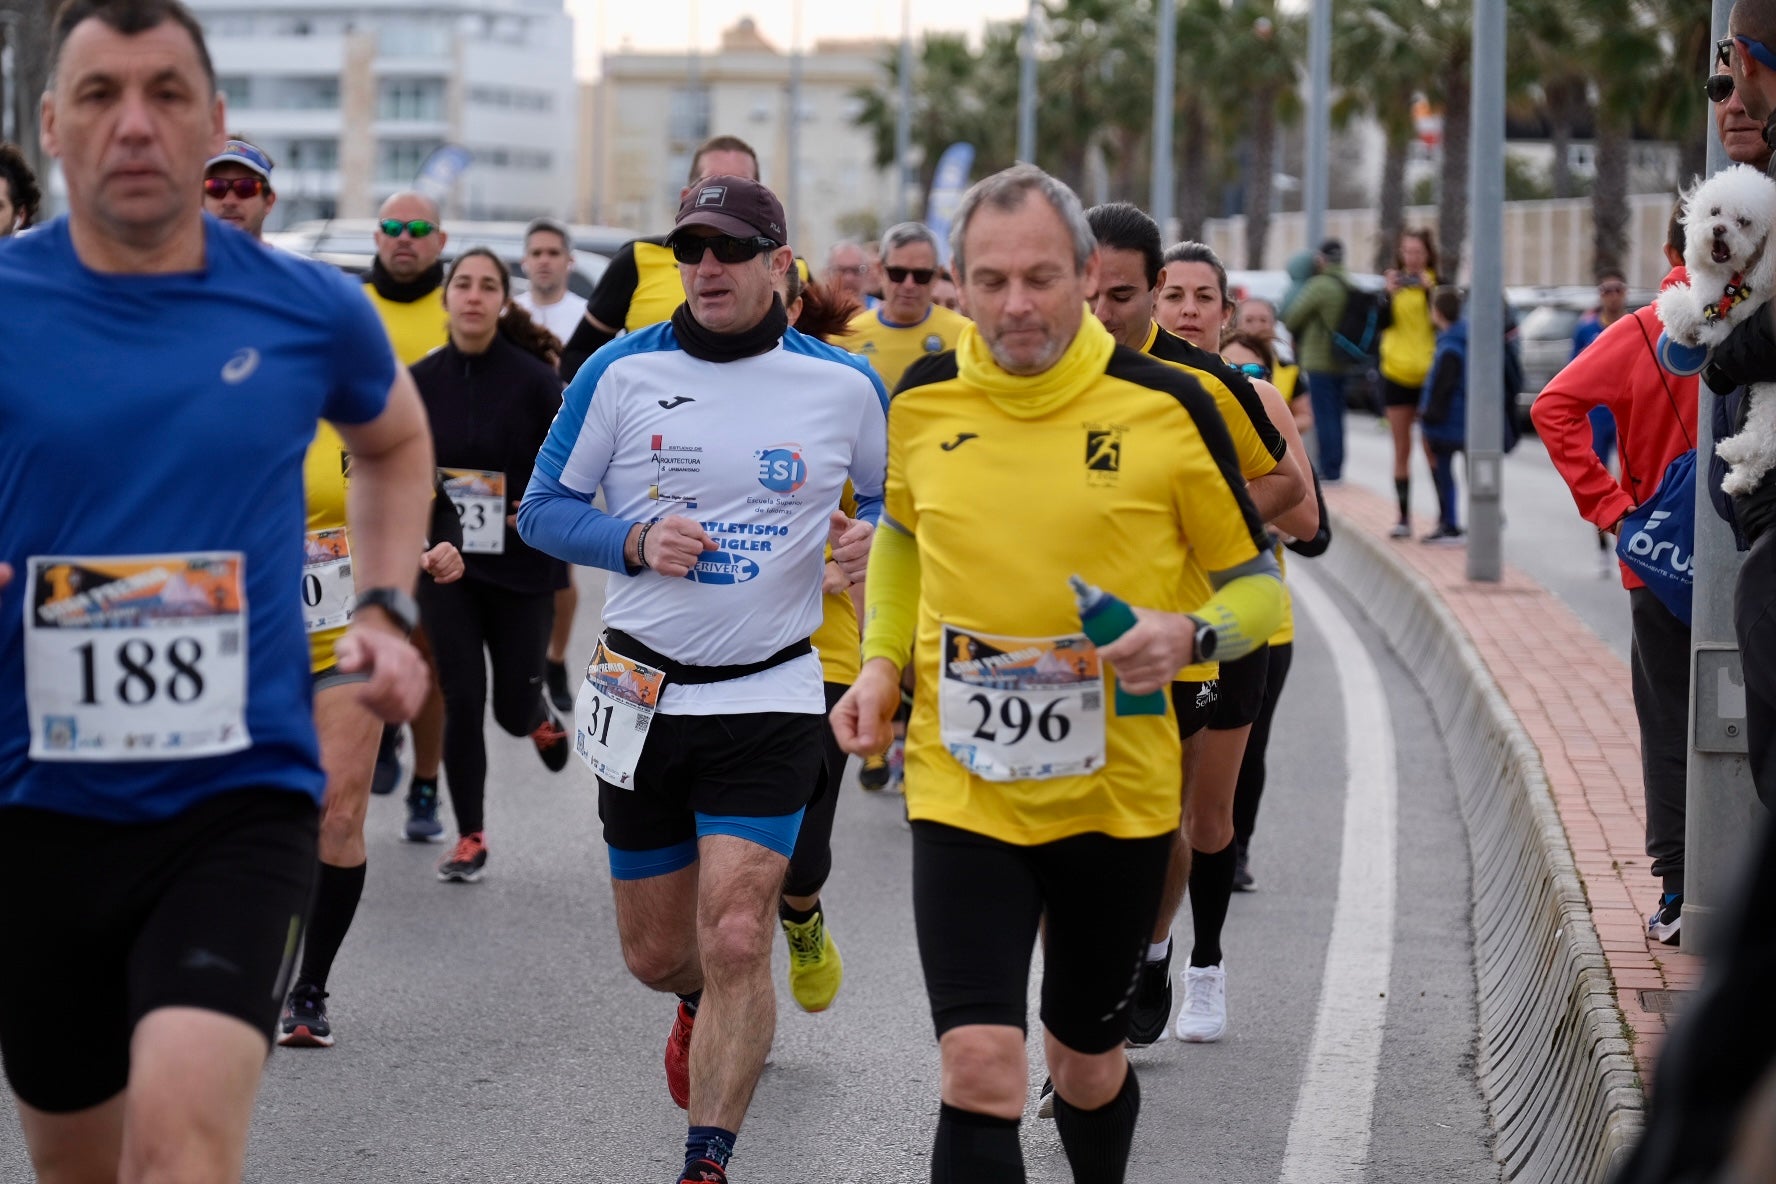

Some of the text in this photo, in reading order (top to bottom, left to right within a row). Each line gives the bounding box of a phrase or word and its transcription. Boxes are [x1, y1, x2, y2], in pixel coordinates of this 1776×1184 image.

[651, 453, 701, 465] ARQUITECTURA
[759, 460, 799, 481] ESI
[746, 496, 803, 507] Escuela Superior
[701, 521, 789, 536] ATLETISMO
[694, 561, 739, 574] ERIVER
[301, 573, 323, 607] 0
[72, 636, 205, 707] 188
[587, 695, 614, 748] 31
[967, 693, 1071, 746] 296
